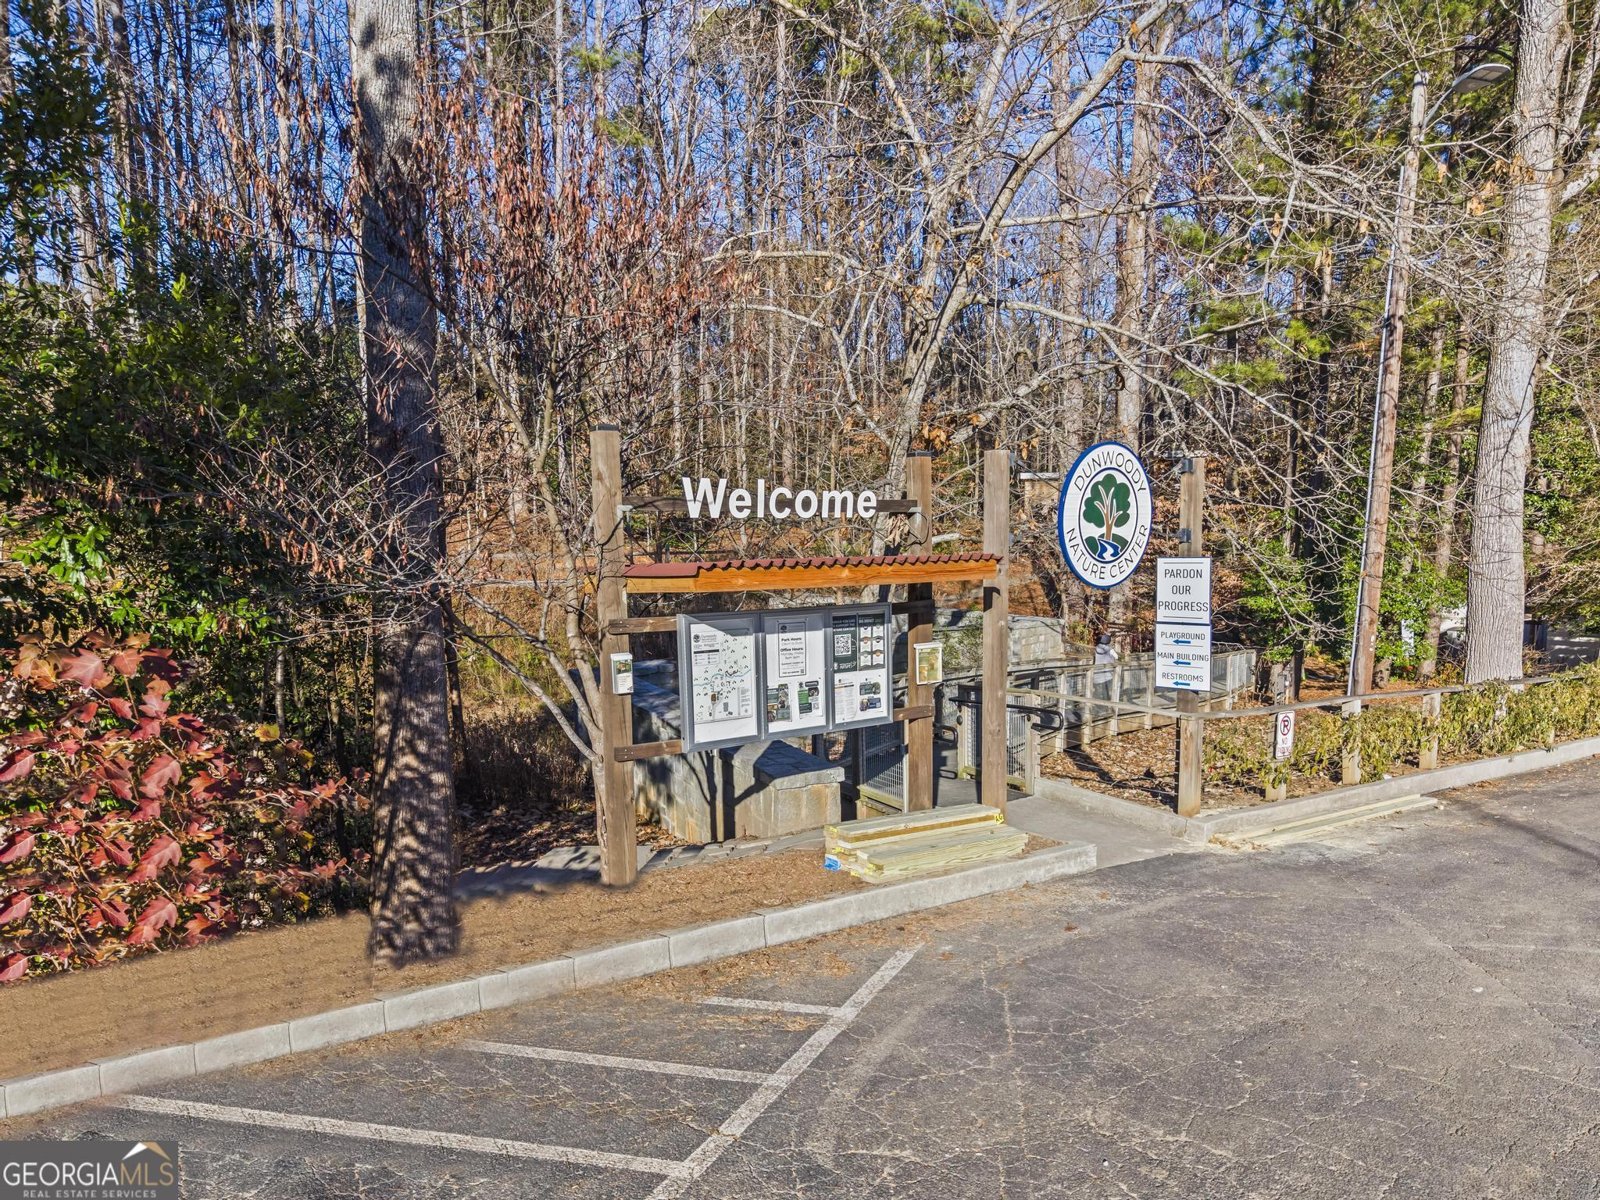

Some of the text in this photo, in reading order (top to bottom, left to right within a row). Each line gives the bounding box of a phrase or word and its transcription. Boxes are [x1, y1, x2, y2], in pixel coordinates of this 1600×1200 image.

[1074, 450, 1147, 492] DUNWOODY
[682, 477, 877, 519] Welcome
[1066, 524, 1148, 580] NATURE CENTER
[1164, 568, 1203, 579] PARDON
[1171, 585, 1192, 595] OUR
[1158, 600, 1209, 613] PROGRESS
[1160, 631, 1206, 641] PLAYGROUND
[1157, 651, 1209, 662] MAIN BUILDING
[1161, 672, 1204, 683] RESTROOMS
